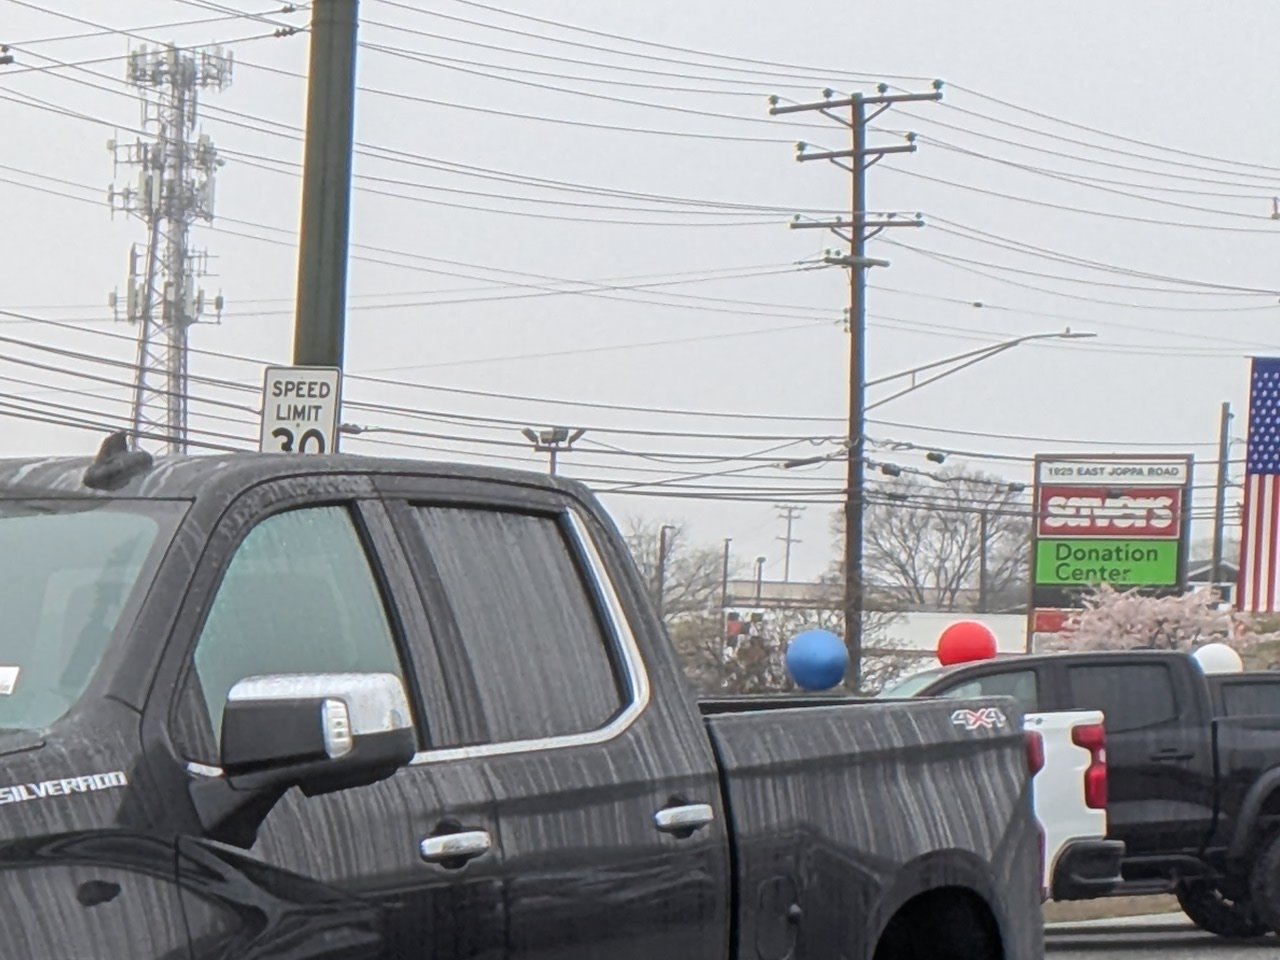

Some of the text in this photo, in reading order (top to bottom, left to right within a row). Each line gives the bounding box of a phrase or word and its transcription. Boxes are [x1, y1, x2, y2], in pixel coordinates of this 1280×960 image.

[272, 380, 331, 398] SPEED
[276, 404, 323, 421] LIMIT
[271, 427, 326, 454] 30
[1077, 467, 1106, 477] EAST
[1108, 467, 1145, 477] JOPPA
[1147, 467, 1180, 477] ROAD
[1055, 543, 1158, 562] Donation
[1055, 563, 1132, 582] Center
